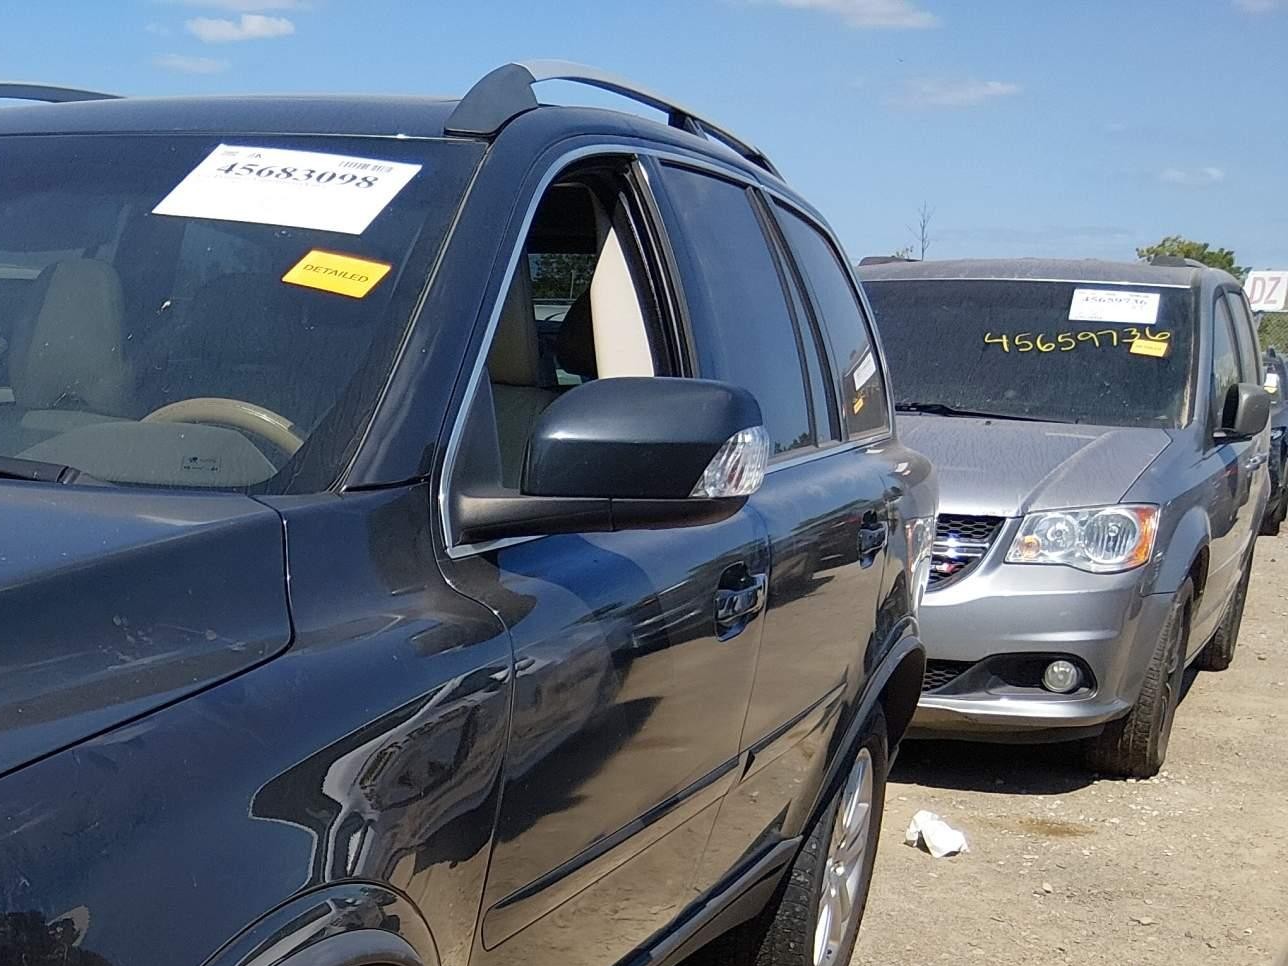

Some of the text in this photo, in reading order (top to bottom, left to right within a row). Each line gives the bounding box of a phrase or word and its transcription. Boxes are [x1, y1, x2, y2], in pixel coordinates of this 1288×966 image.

[217, 162, 380, 189] 45683098
[303, 263, 369, 284] DETAILED
[983, 327, 1171, 353] 45659736
